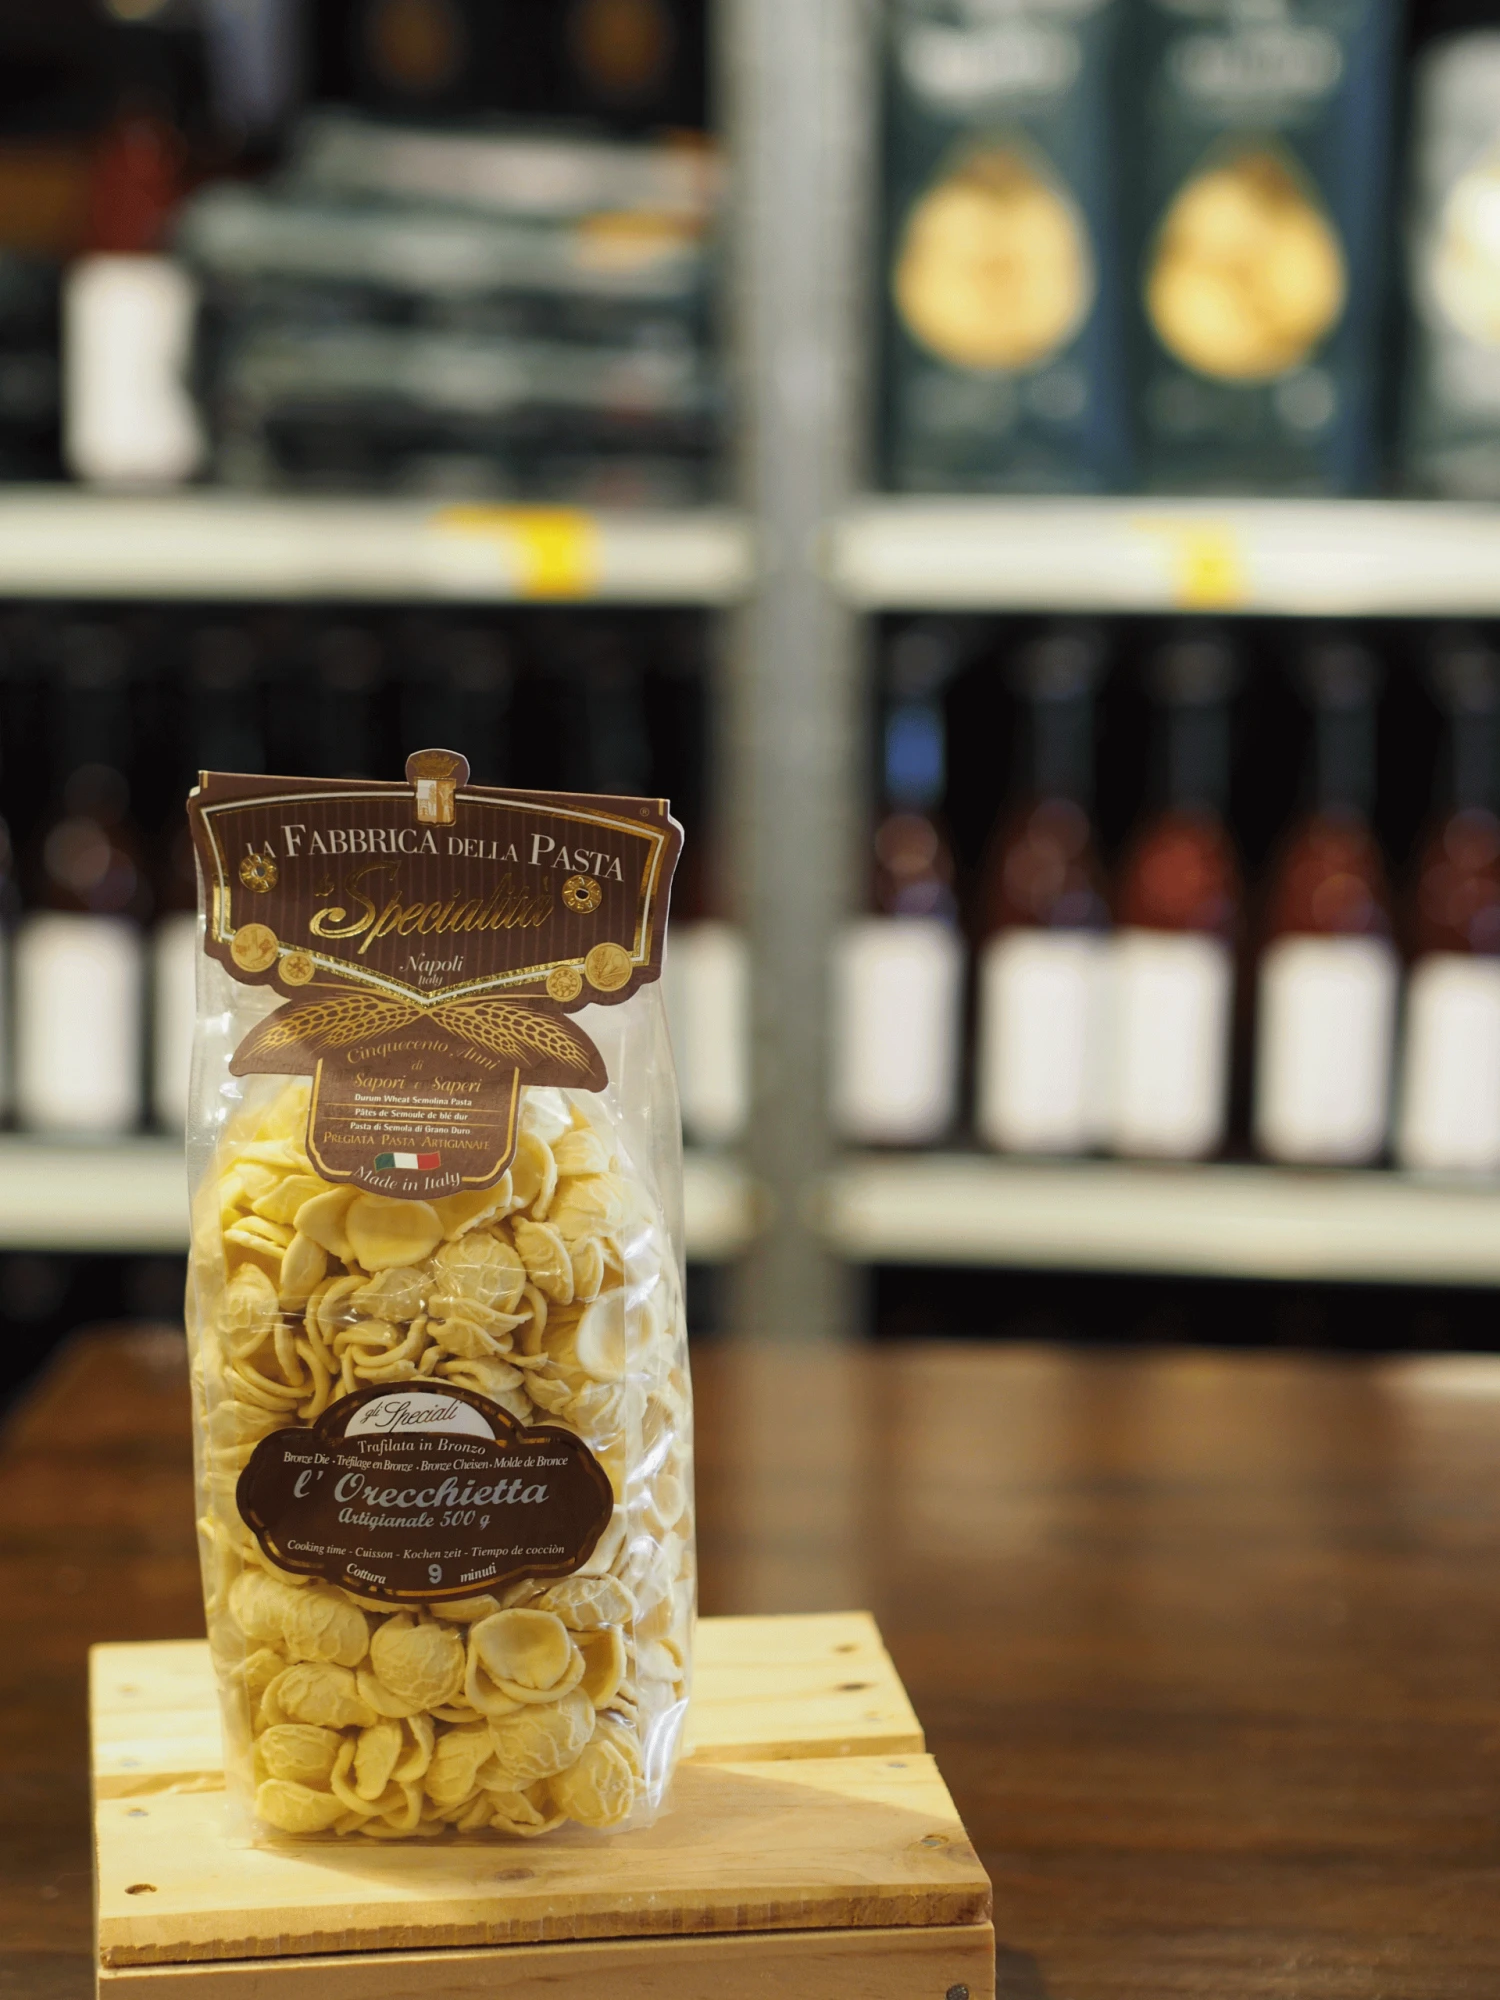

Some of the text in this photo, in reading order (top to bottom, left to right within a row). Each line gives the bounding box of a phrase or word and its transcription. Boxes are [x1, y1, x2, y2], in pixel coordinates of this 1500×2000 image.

[281, 824, 439, 858] FABBRICA
[447, 836, 519, 863] DELLA
[528, 833, 624, 882] PASTA
[400, 952, 464, 973] Napoli
[417, 972, 443, 988] Italy
[347, 1040, 501, 1071] Cinquecento Anni
[411, 1060, 424, 1070] di
[354, 1073, 407, 1092] Sapori
[432, 1076, 483, 1095] Saperi
[354, 1093, 472, 1107] Durum Wheat Semolina Pasta
[354, 1108, 468, 1121] Pâtes de Semoule de blé dur
[323, 1131, 375, 1145] PREGIATA
[381, 1134, 416, 1147] PASTA
[350, 1122, 471, 1135] Pasta di Semola di Grano Duro
[352, 1166, 461, 1191] Made in Italy
[360, 1400, 462, 1433] gli Speciali
[357, 1438, 486, 1456] Trafilata in Bronzo
[283, 1451, 569, 1472] Bronze Die Tréfilage en Bronze Bronze Cheisen Molde de Bronce
[334, 1472, 550, 1508] Orecchietta
[338, 1507, 491, 1530] Artigianale 500 g
[287, 1540, 325, 1555] Cooking
[326, 1545, 347, 1555] time
[355, 1547, 393, 1559] Cuisson
[403, 1549, 441, 1559] Kochen
[443, 1548, 462, 1558] zeit
[470, 1547, 509, 1559] Tiempo
[511, 1546, 523, 1555] de
[525, 1544, 565, 1555] cocciòn
[346, 1562, 497, 1584] Cottura 9 minuti
